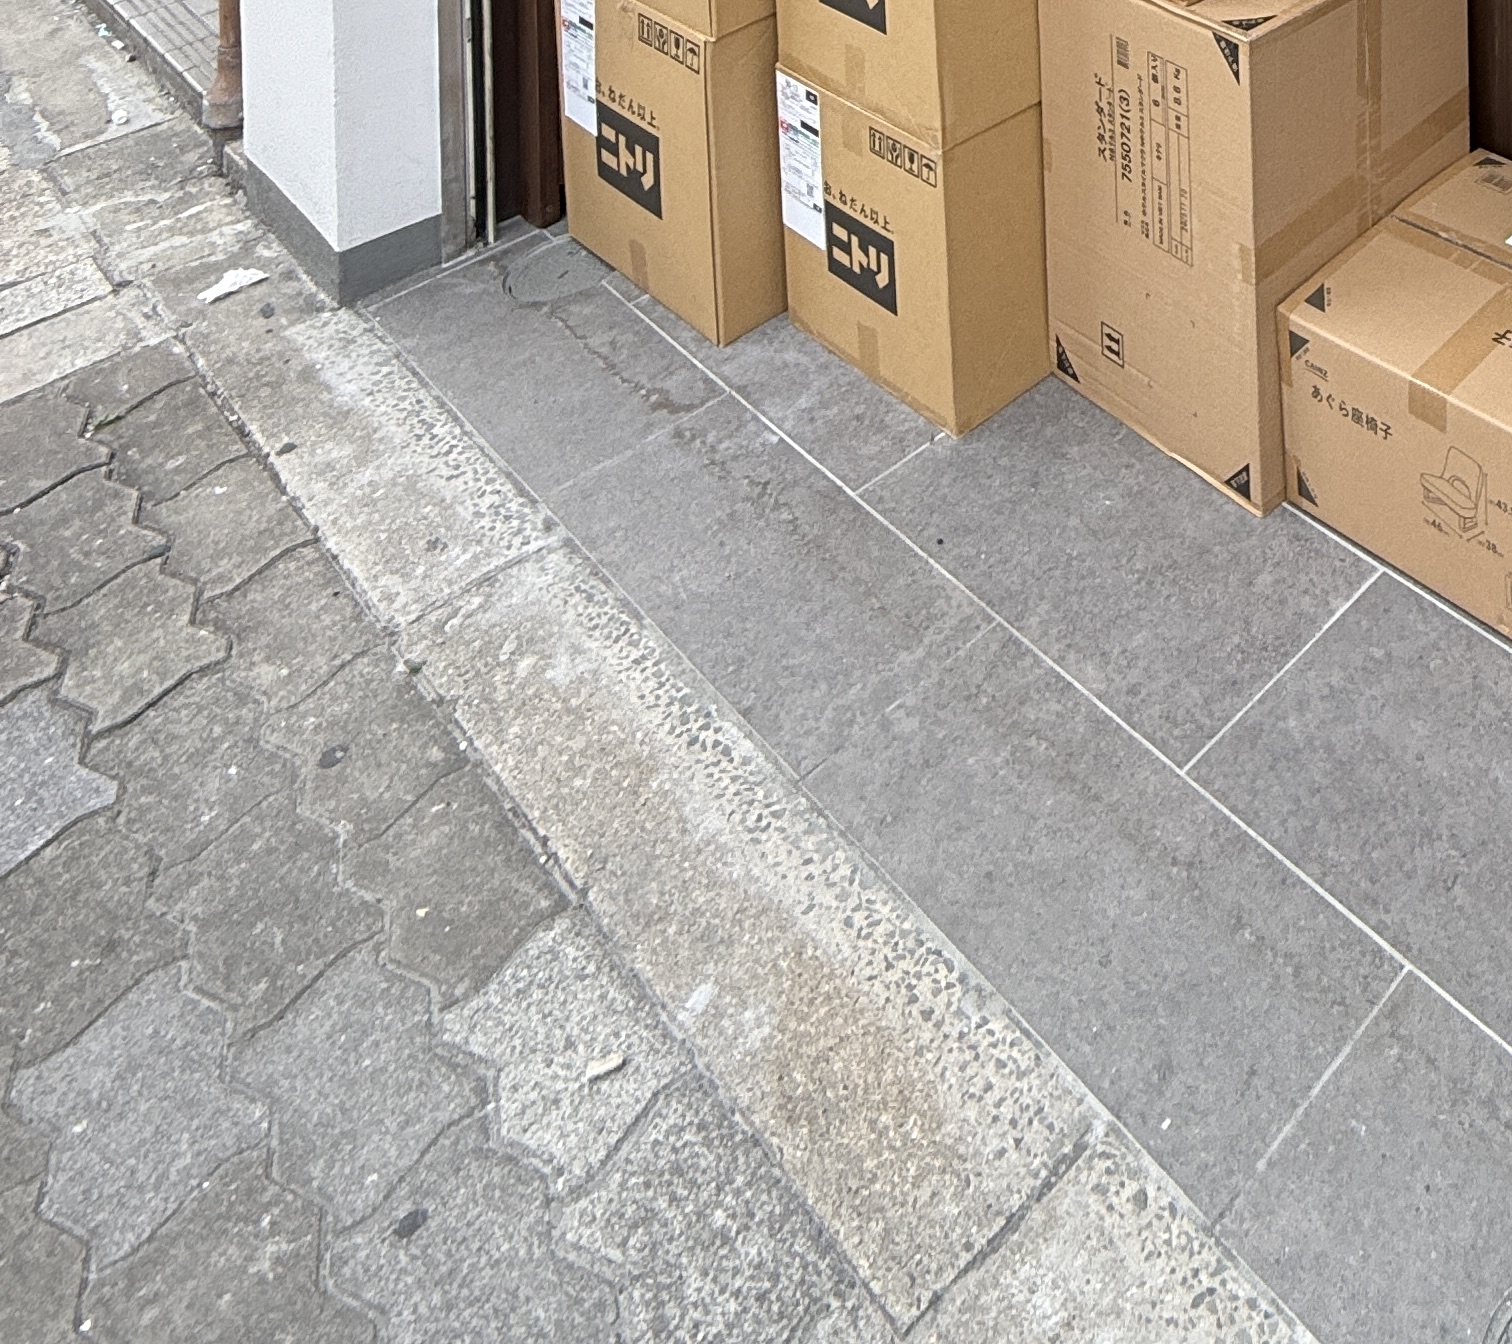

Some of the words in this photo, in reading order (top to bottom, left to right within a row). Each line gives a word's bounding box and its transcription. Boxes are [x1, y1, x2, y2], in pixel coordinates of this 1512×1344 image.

[1094, 72, 1108, 162] スタンダード
[1118, 88, 1133, 184] 7550721(3)
[600, 121, 655, 192] ニトリ
[823, 180, 895, 235] お、ねだん以上。
[831, 220, 890, 290] ニトリ
[1304, 359, 1329, 378] CAINZ
[1311, 384, 1394, 440] あぐら座椅子
